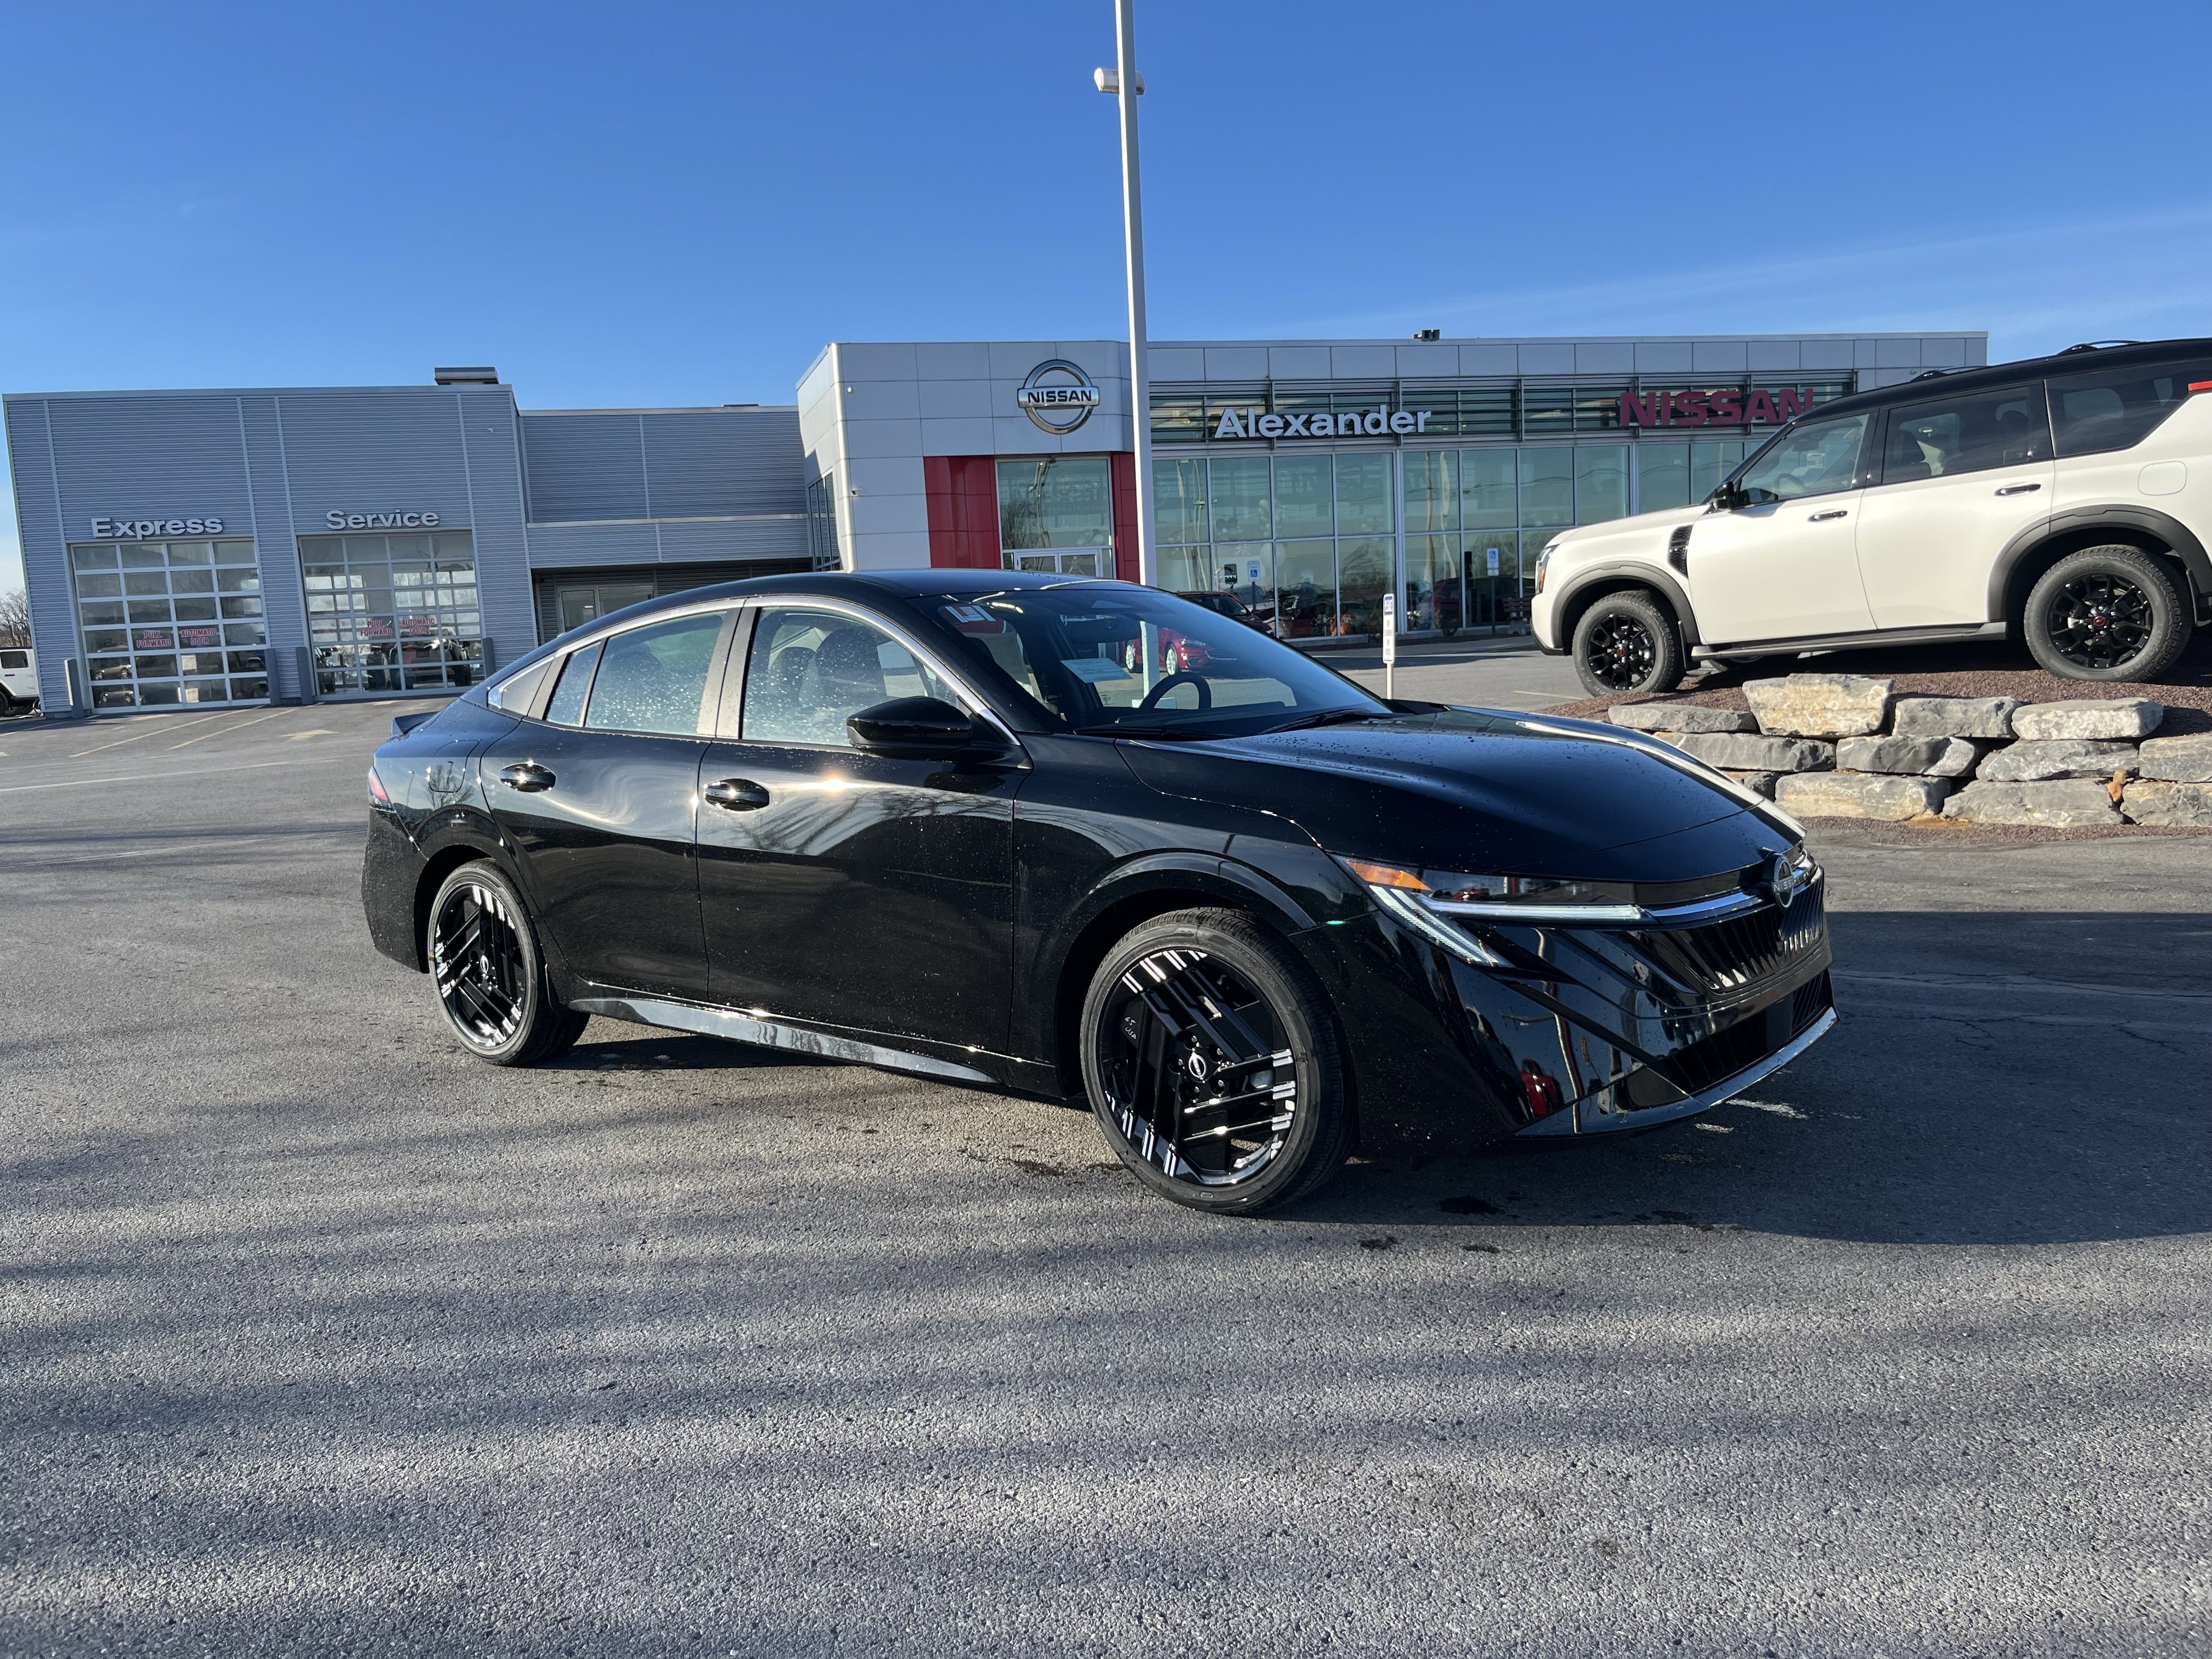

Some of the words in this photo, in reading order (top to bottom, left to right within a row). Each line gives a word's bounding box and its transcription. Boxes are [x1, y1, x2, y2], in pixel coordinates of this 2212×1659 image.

[1028, 390, 1092, 403] NISSAN
[1620, 388, 1813, 426] NISSAN
[1214, 404, 1431, 438] Alexander
[326, 509, 439, 529] Service
[91, 518, 223, 540] Express
[402, 618, 436, 627] AUTOMATIC
[144, 630, 162, 639] PULL
[181, 628, 217, 637] AUTOMATIC
[360, 628, 392, 637] FORWARD
[409, 627, 427, 635] DOOR
[137, 639, 172, 648] FORWARD
[190, 637, 210, 645] DOOR
[1125, 1027, 1136, 1039] USA
